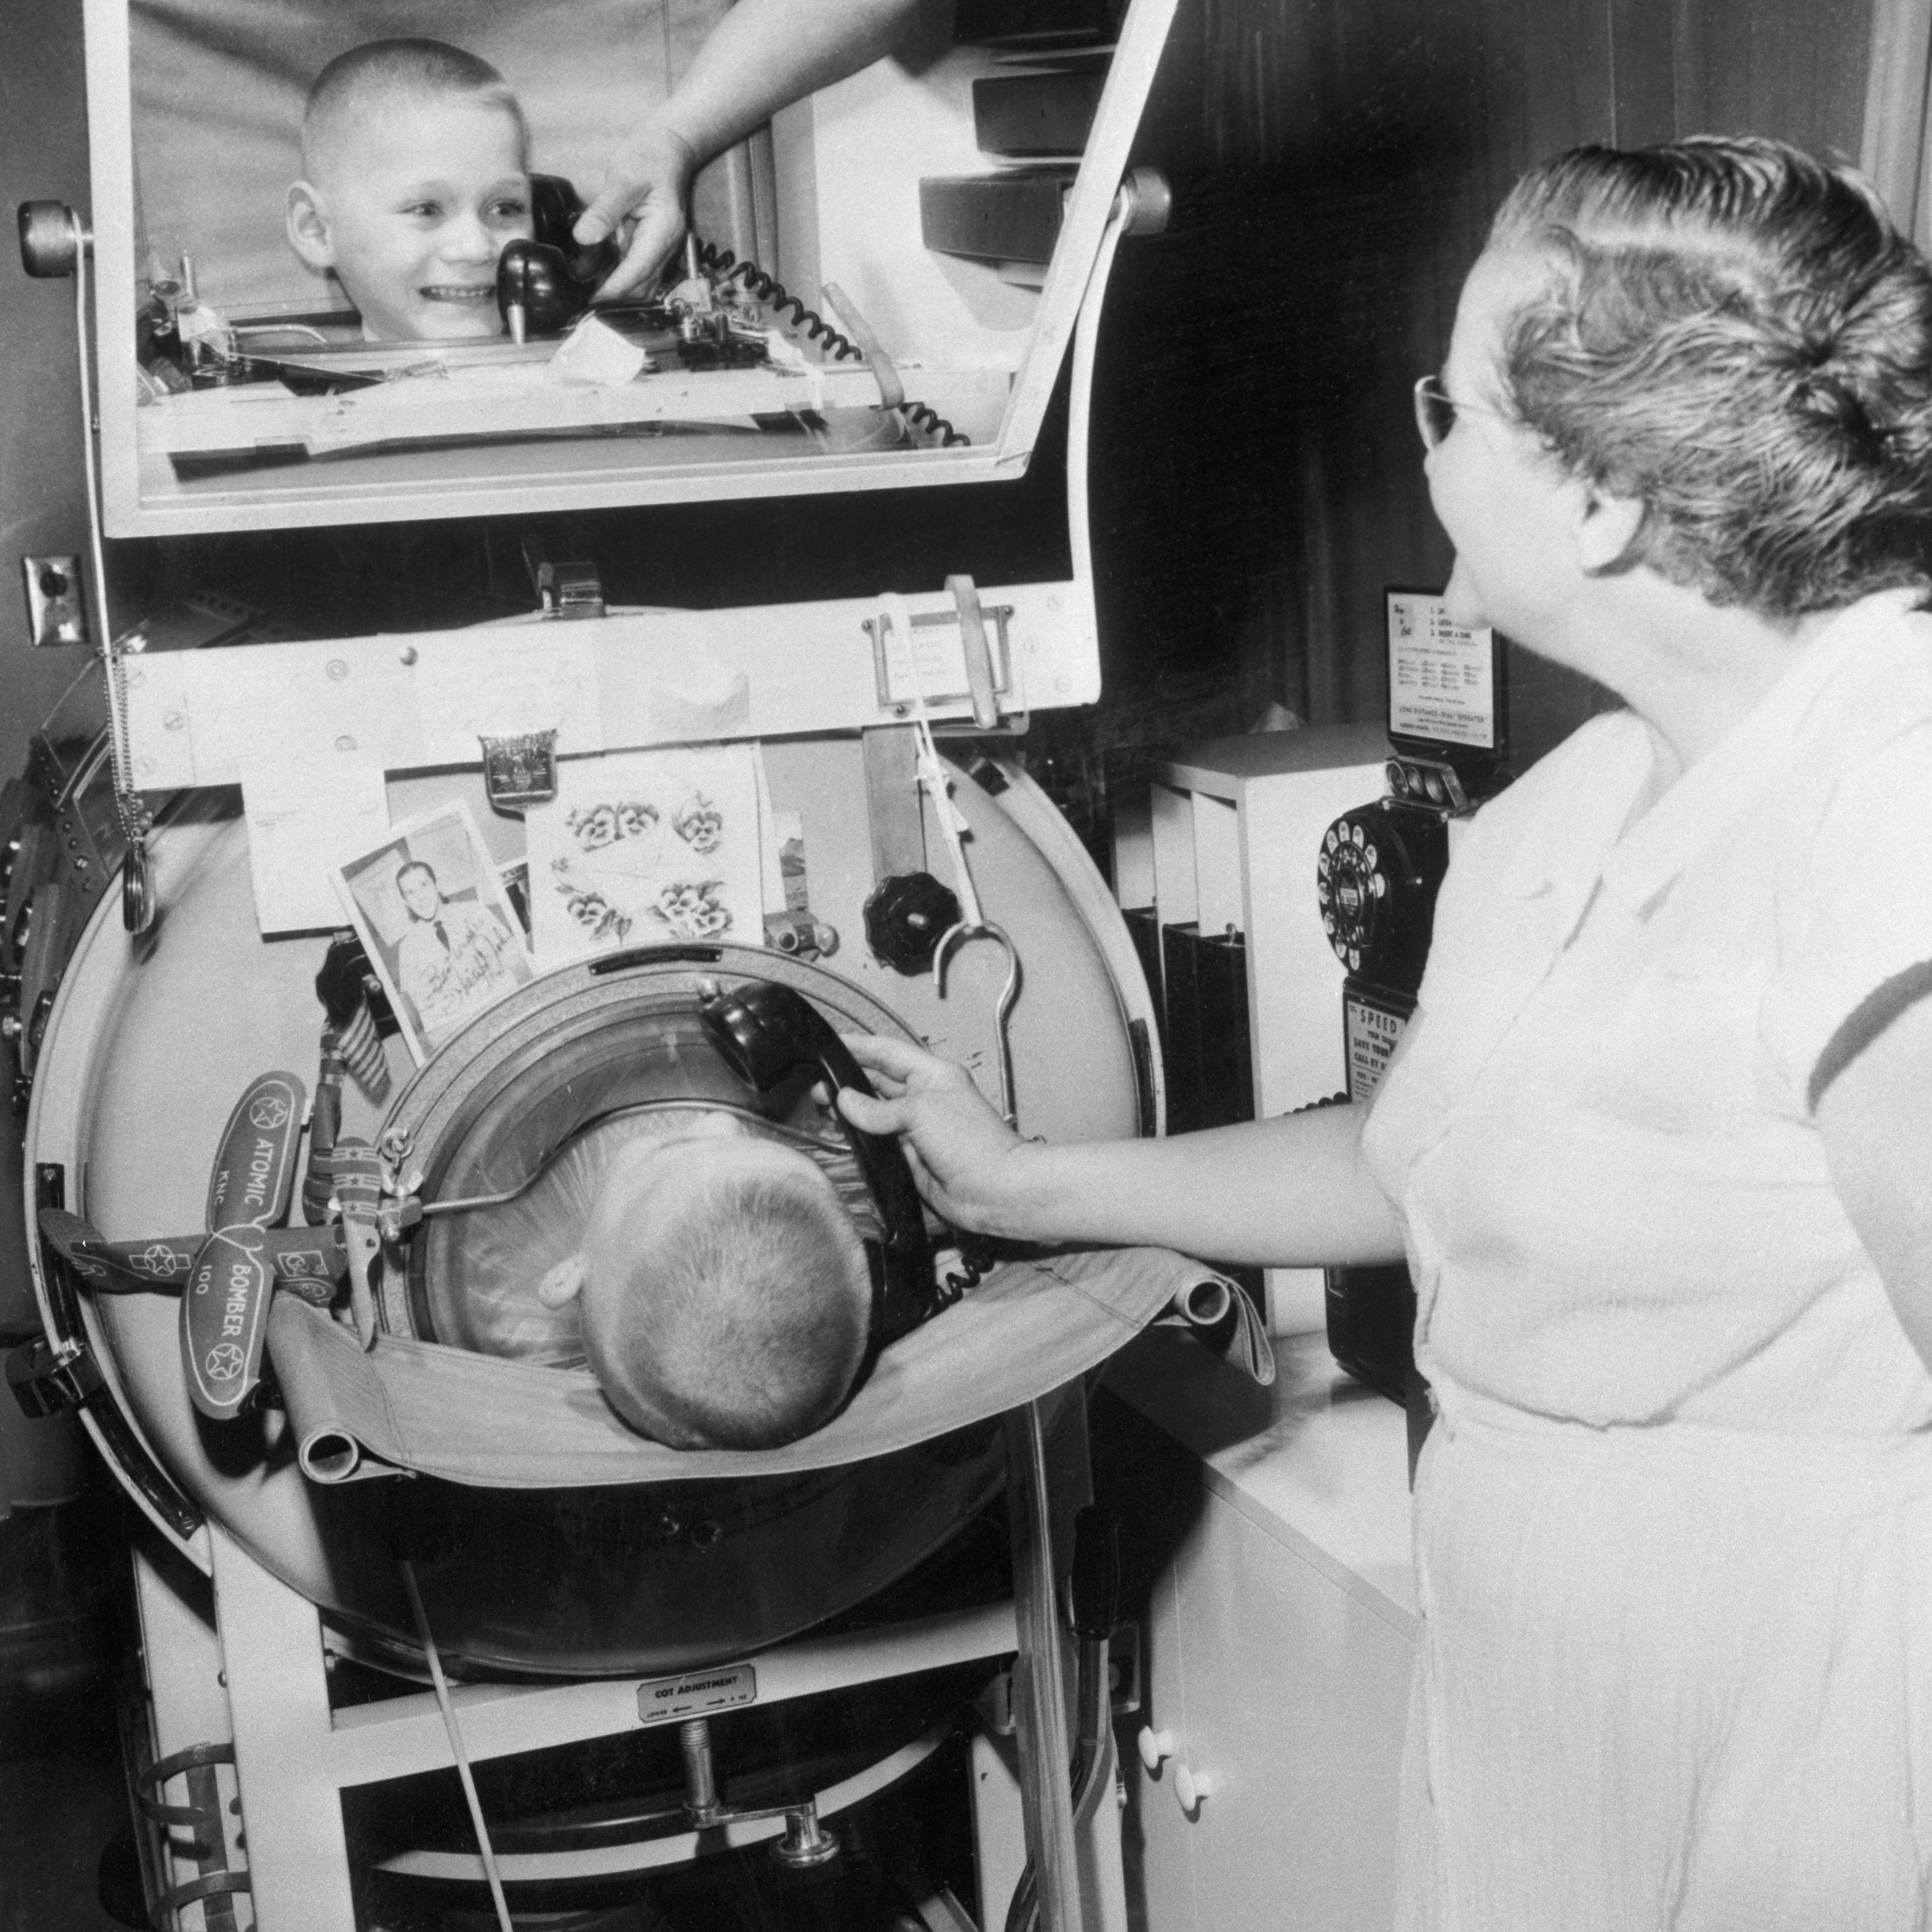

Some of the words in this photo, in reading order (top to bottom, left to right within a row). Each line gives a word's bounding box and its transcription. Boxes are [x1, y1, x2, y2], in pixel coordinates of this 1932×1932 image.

[1360, 1009, 1397, 1033] SPEED
[1367, 1030, 1379, 1040] YOUR
[1354, 1037, 1369, 1051] SAVE
[1372, 1043, 1389, 1058] YOUR
[1354, 1052, 1368, 1064] CALL
[1371, 1058, 1379, 1068] BY
[244, 1138, 274, 1206] ATOMIC
[221, 1264, 251, 1337] BOMBER
[655, 1687, 674, 1698] COT
[677, 1676, 738, 1695] ADJUSTMENT
